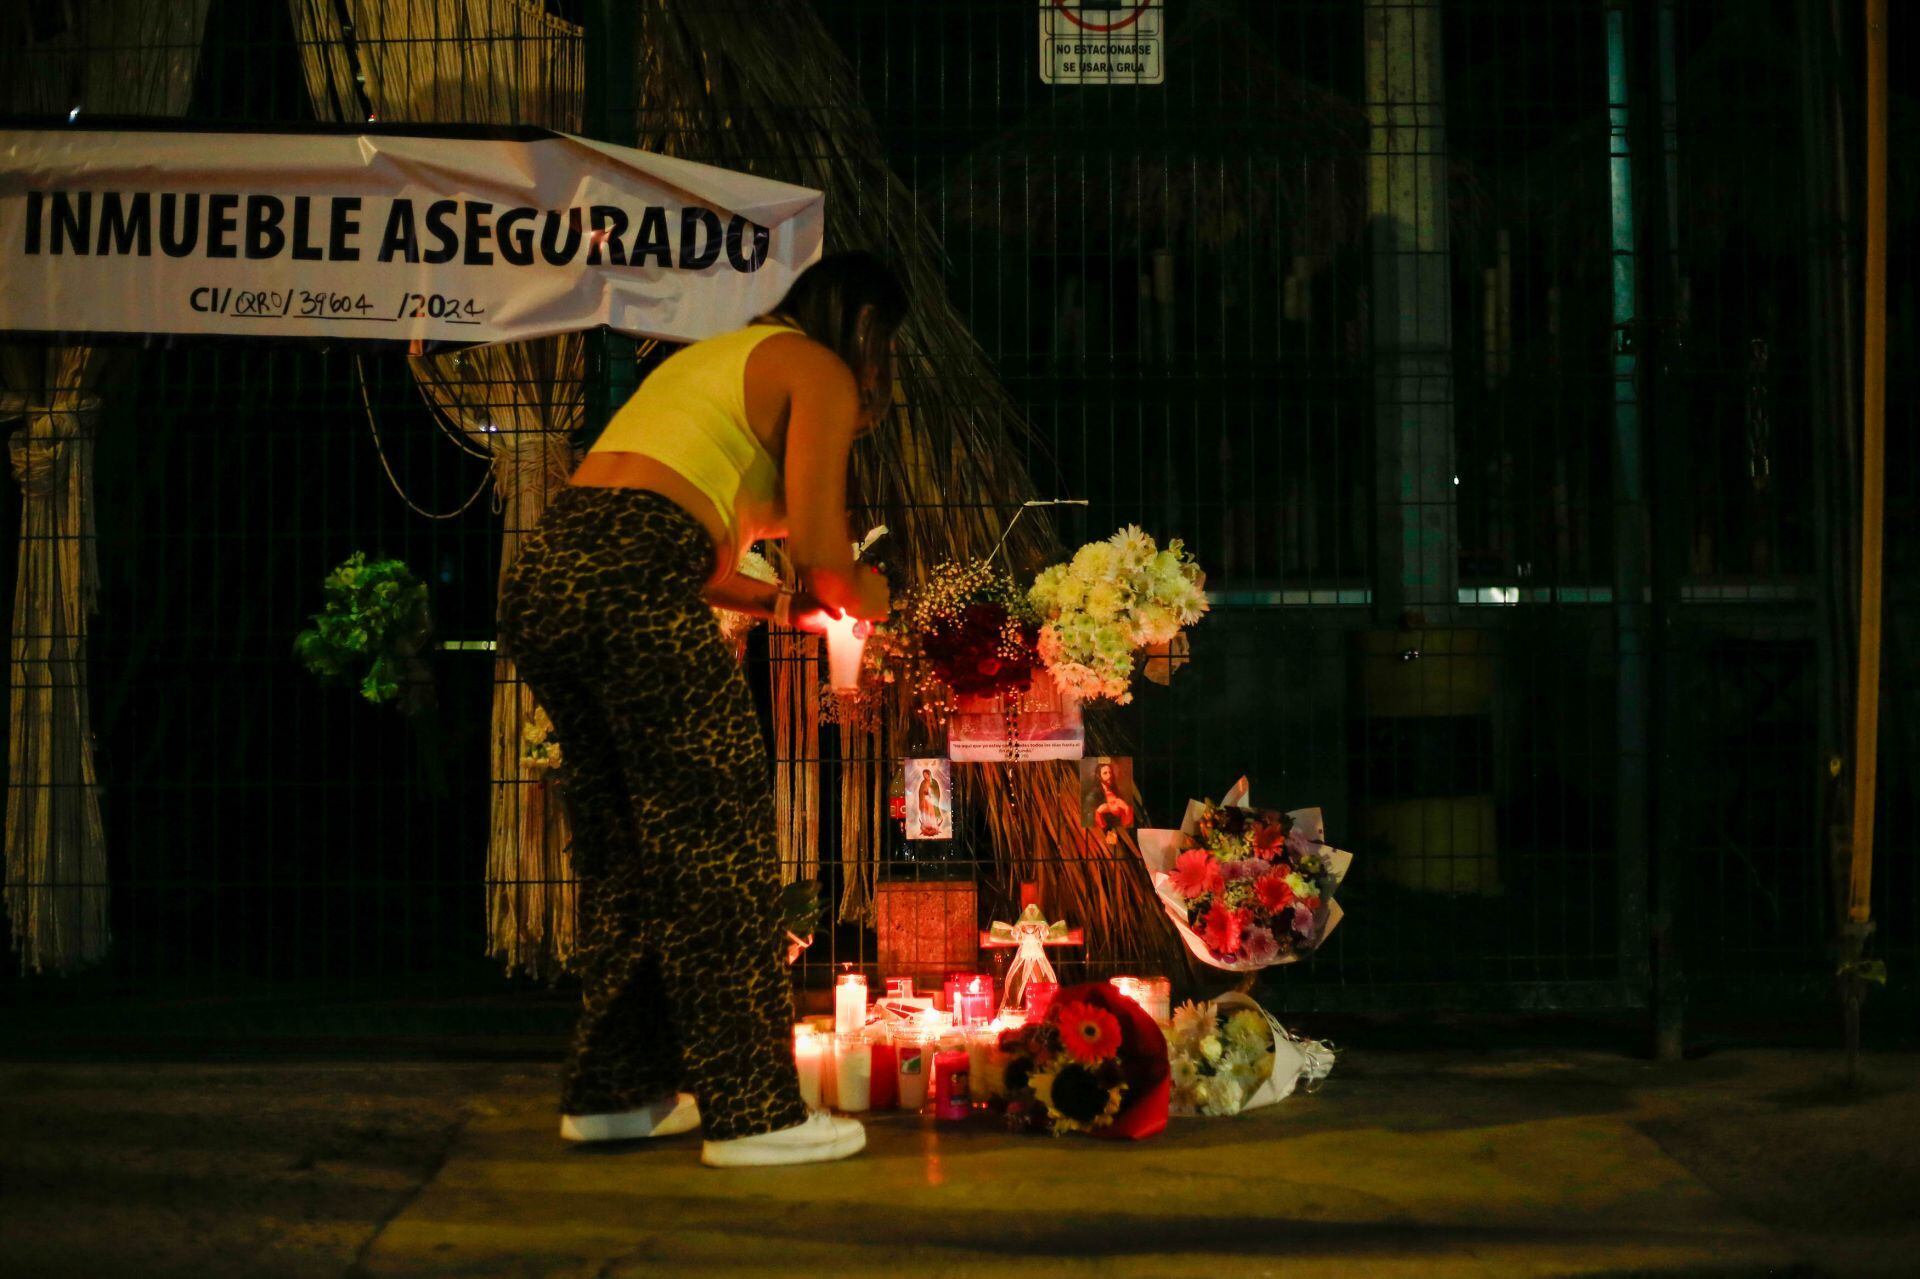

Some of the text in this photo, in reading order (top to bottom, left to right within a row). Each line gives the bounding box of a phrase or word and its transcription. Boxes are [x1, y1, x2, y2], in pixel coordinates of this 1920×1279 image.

[1056, 44, 1071, 54] NO
[1063, 62, 1075, 72] SE
[1117, 62, 1145, 72] GRUA
[24, 190, 770, 273] INMUEBLE ASEGURADO
